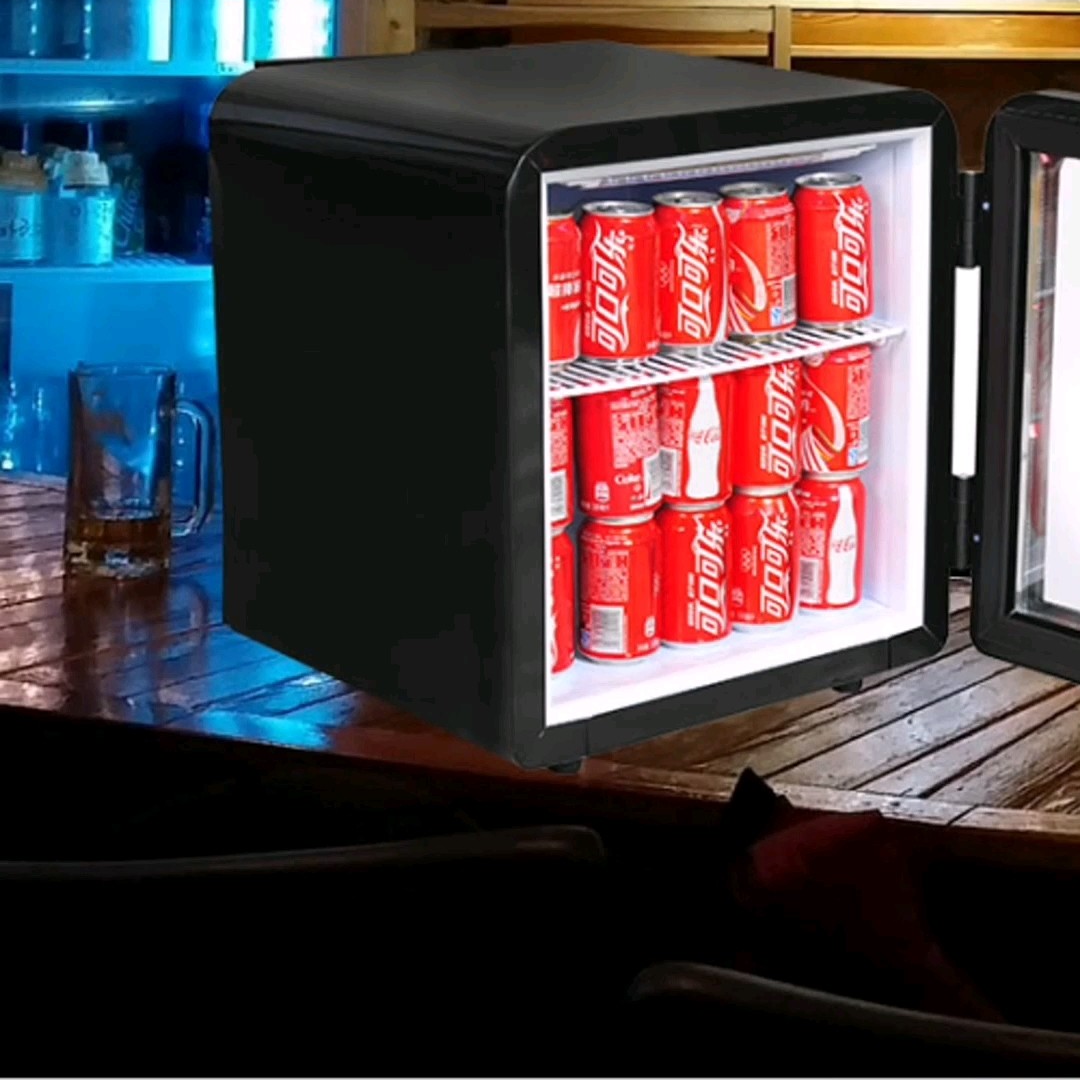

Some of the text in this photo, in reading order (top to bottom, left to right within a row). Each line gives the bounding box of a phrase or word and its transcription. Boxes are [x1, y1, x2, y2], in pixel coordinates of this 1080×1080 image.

[590, 219, 636, 353] 可口可乐
[675, 219, 716, 340] 可口可乐
[834, 192, 870, 314] 可口可乐
[765, 363, 801, 479] 可口可乐
[692, 512, 730, 635] 可口可乐
[758, 508, 795, 618] 可口可乐
